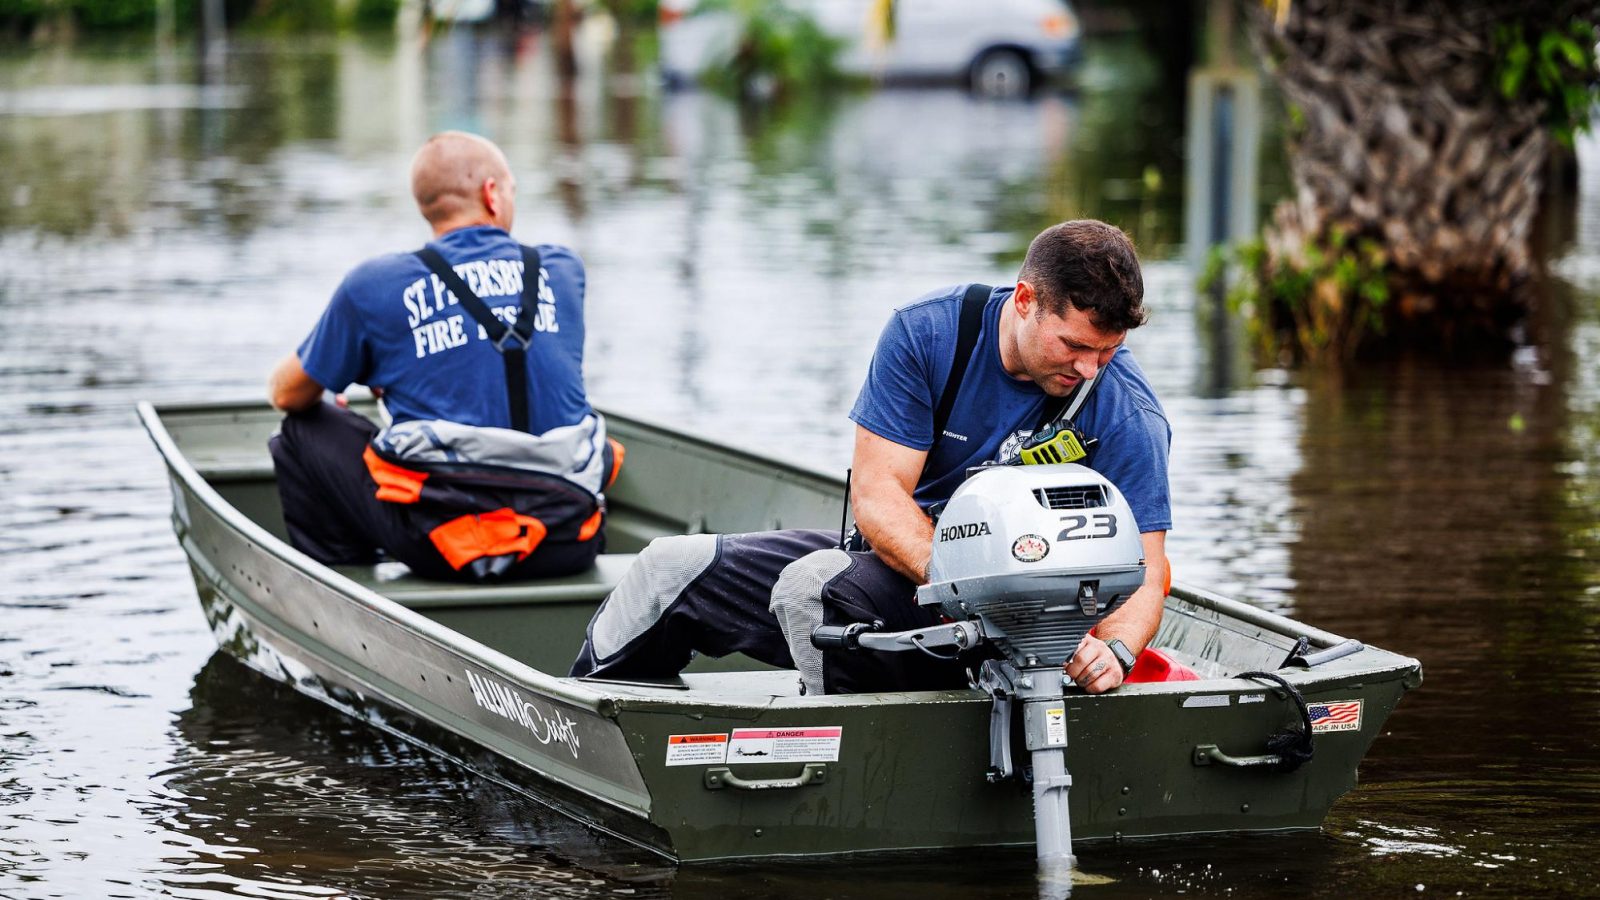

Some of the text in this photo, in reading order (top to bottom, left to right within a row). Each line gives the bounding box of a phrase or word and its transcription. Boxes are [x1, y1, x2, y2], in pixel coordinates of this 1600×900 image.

[403, 278, 433, 329] ST.
[412, 314, 469, 359] FIRE
[942, 430, 968, 442] FIGHTER
[939, 521, 992, 543] HONDA
